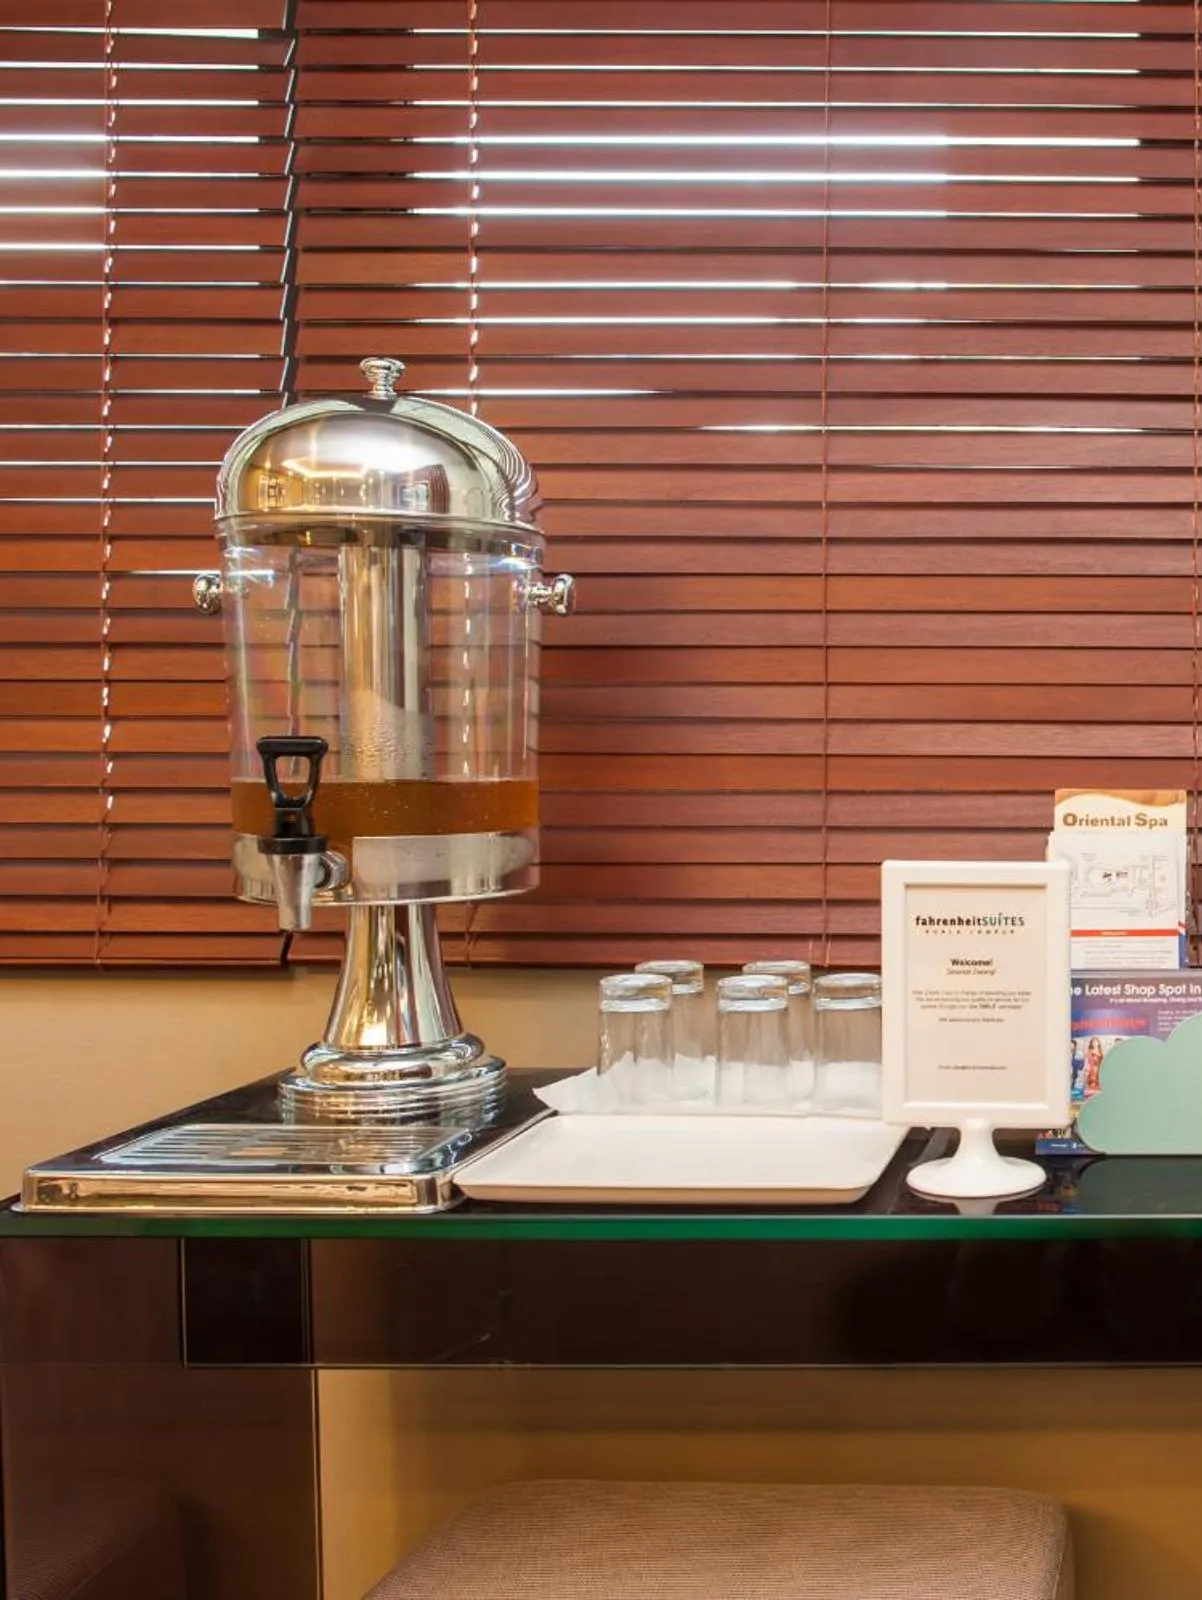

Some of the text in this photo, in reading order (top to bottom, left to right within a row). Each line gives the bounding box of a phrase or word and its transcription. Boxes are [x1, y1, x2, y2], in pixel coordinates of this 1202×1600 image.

[1062, 812, 1168, 829] Oriental Spa
[1085, 984, 1121, 996] Latest
[1124, 983, 1156, 997] Shop
[1158, 983, 1186, 997] Spot
